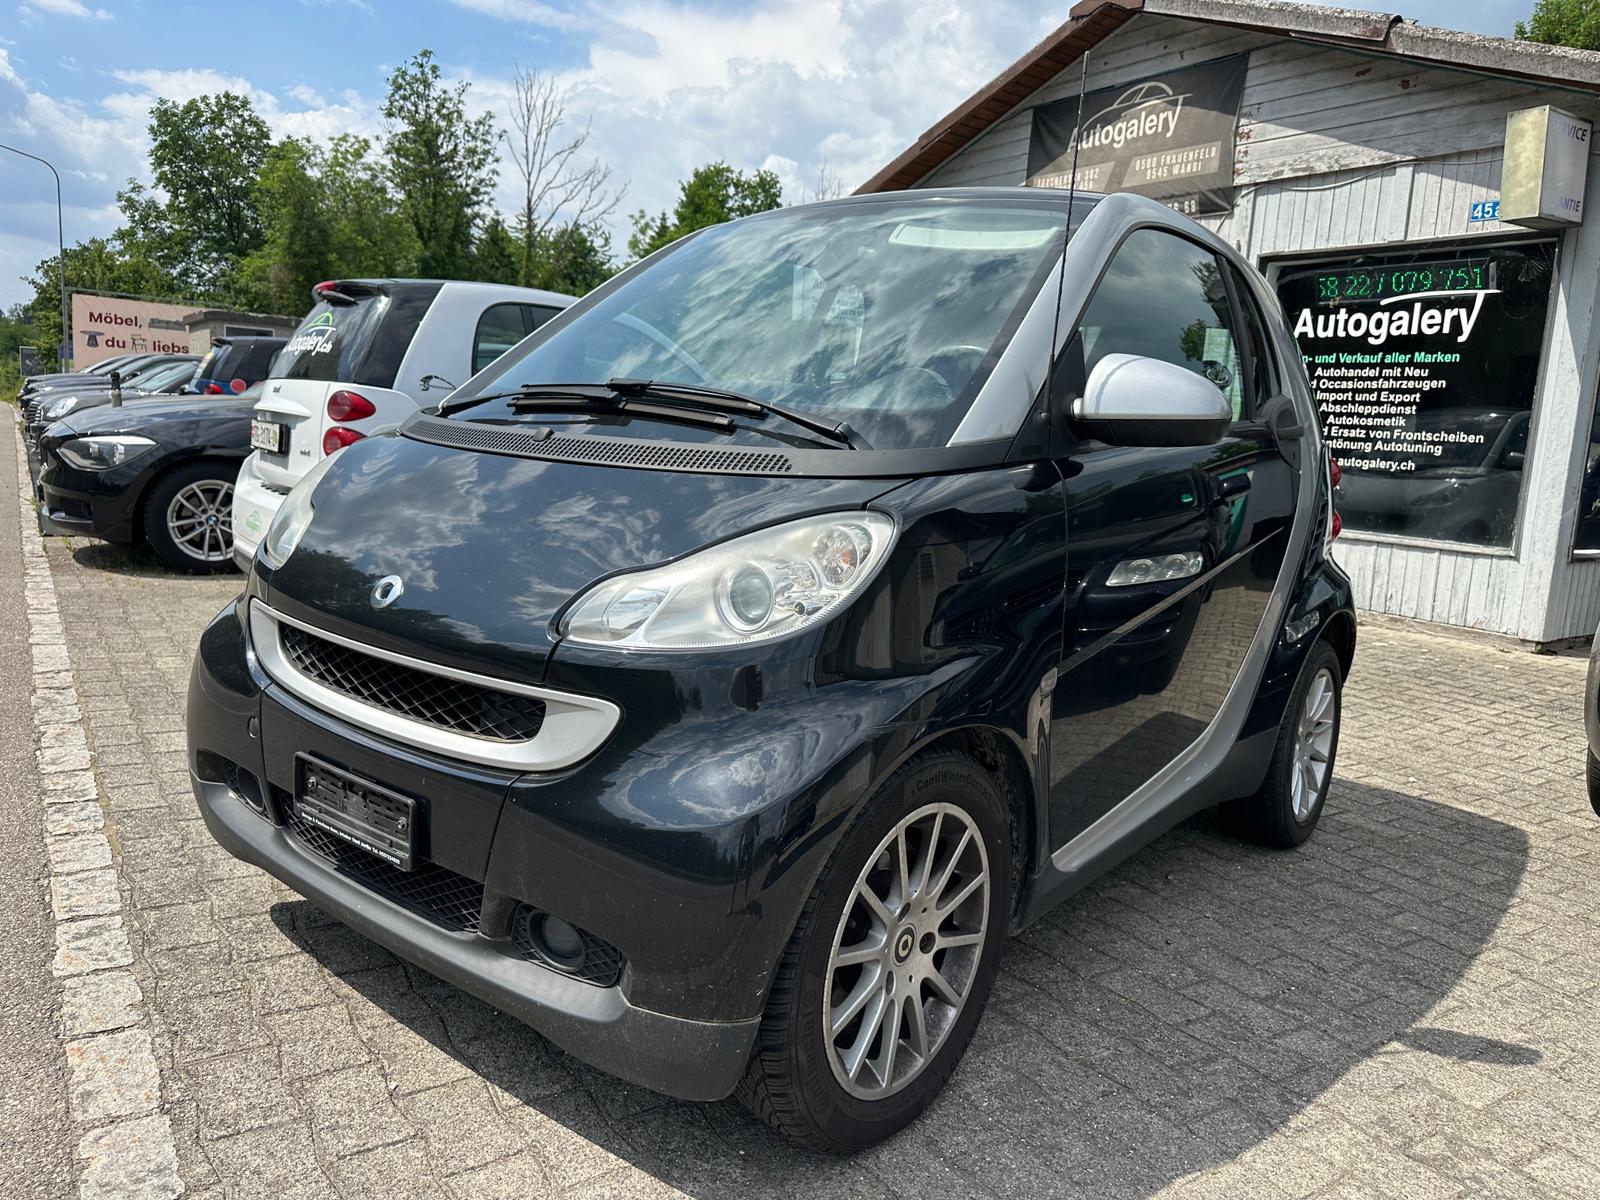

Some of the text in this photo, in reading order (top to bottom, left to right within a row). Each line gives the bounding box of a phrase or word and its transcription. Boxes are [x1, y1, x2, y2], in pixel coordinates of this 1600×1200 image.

[1067, 99, 1187, 153] Autogalery
[1135, 147, 1216, 171] 8500 FRAUENFELD
[1145, 166, 1169, 181] 9545
[1391, 270, 1433, 292] 079
[1439, 267, 1483, 290] 751
[88, 311, 143, 330] Möbel,
[1293, 291, 1494, 345] Autogalery
[105, 336, 126, 349] du
[1301, 351, 1461, 364] n- und Verkauf aller Marken
[1314, 366, 1430, 378] Autohandel mit Neu
[1319, 378, 1447, 392] Occasionsfahrzeugen
[1316, 390, 1421, 406] Import und Export
[1319, 402, 1417, 416] Abschleppdienst
[1326, 414, 1407, 428] Autokosmetik
[1330, 426, 1367, 439] Ersatz
[1369, 430, 1391, 440] von
[1393, 429, 1485, 445] Frontscheiben
[1323, 438, 1443, 457] ntönung Autotuning
[1332, 457, 1416, 473] autogalery.ch
